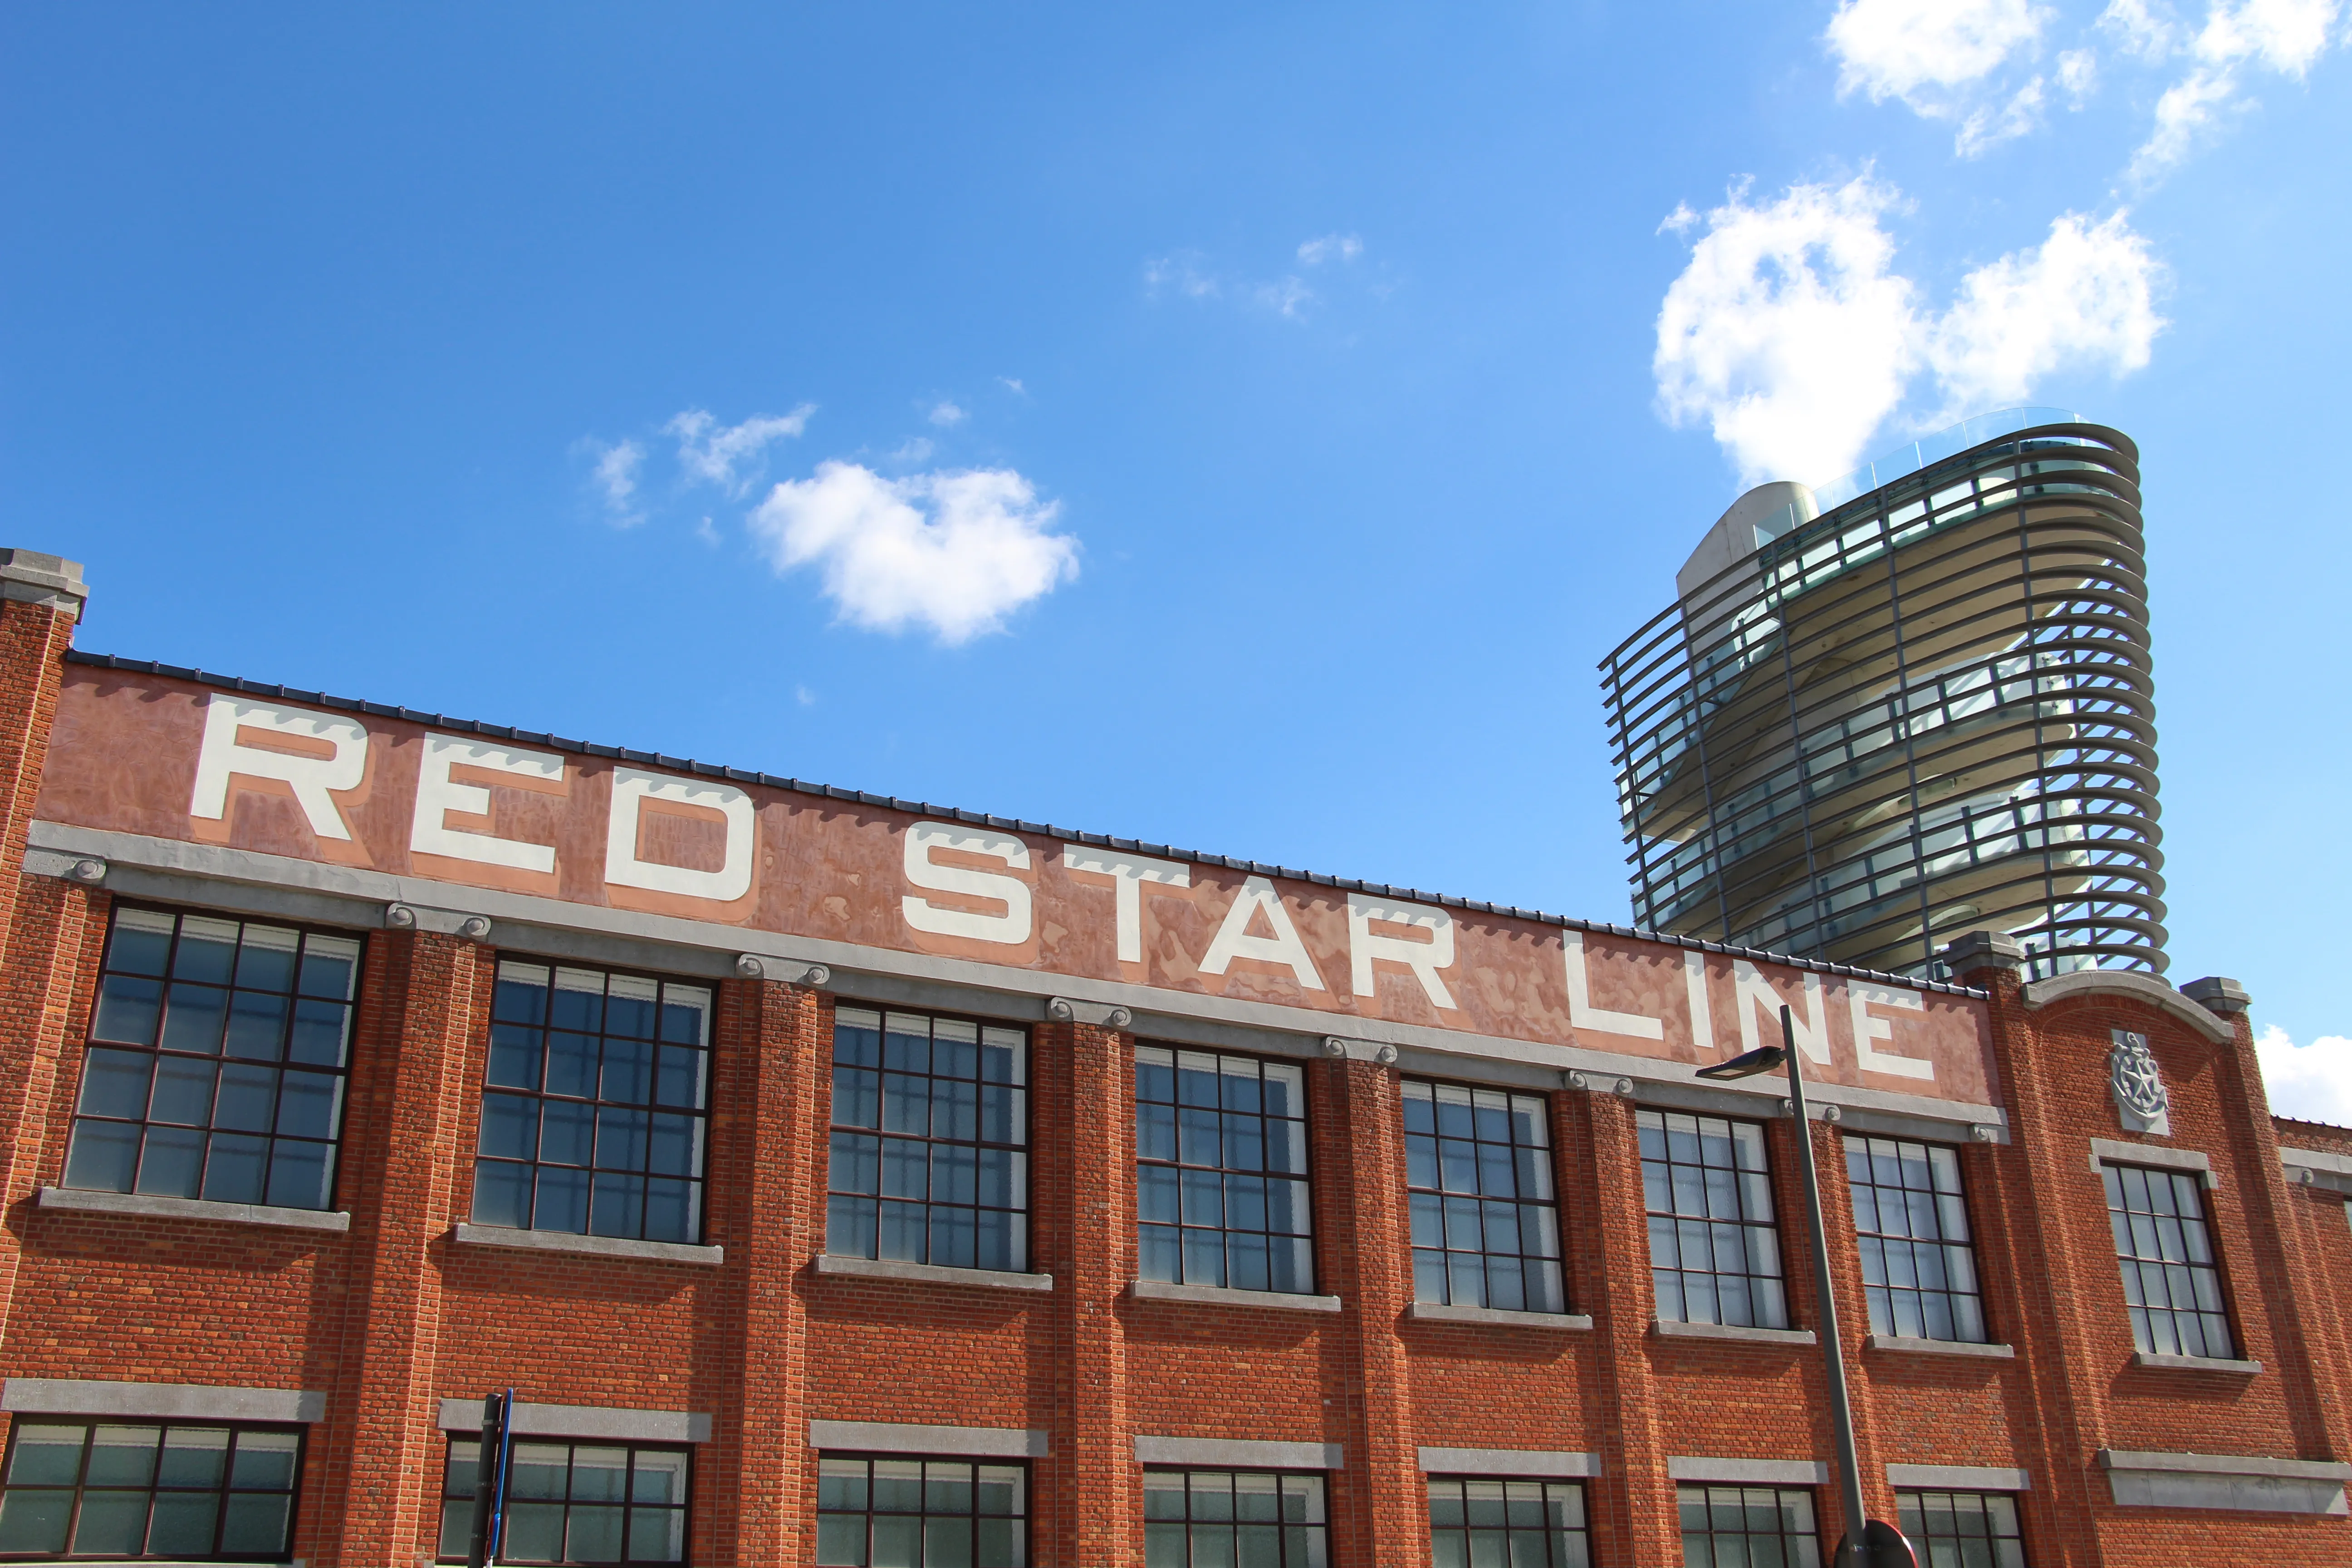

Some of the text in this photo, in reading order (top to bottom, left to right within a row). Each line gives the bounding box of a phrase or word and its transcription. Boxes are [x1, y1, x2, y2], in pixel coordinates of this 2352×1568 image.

[190, 692, 1935, 1081] RED STAR LINE
